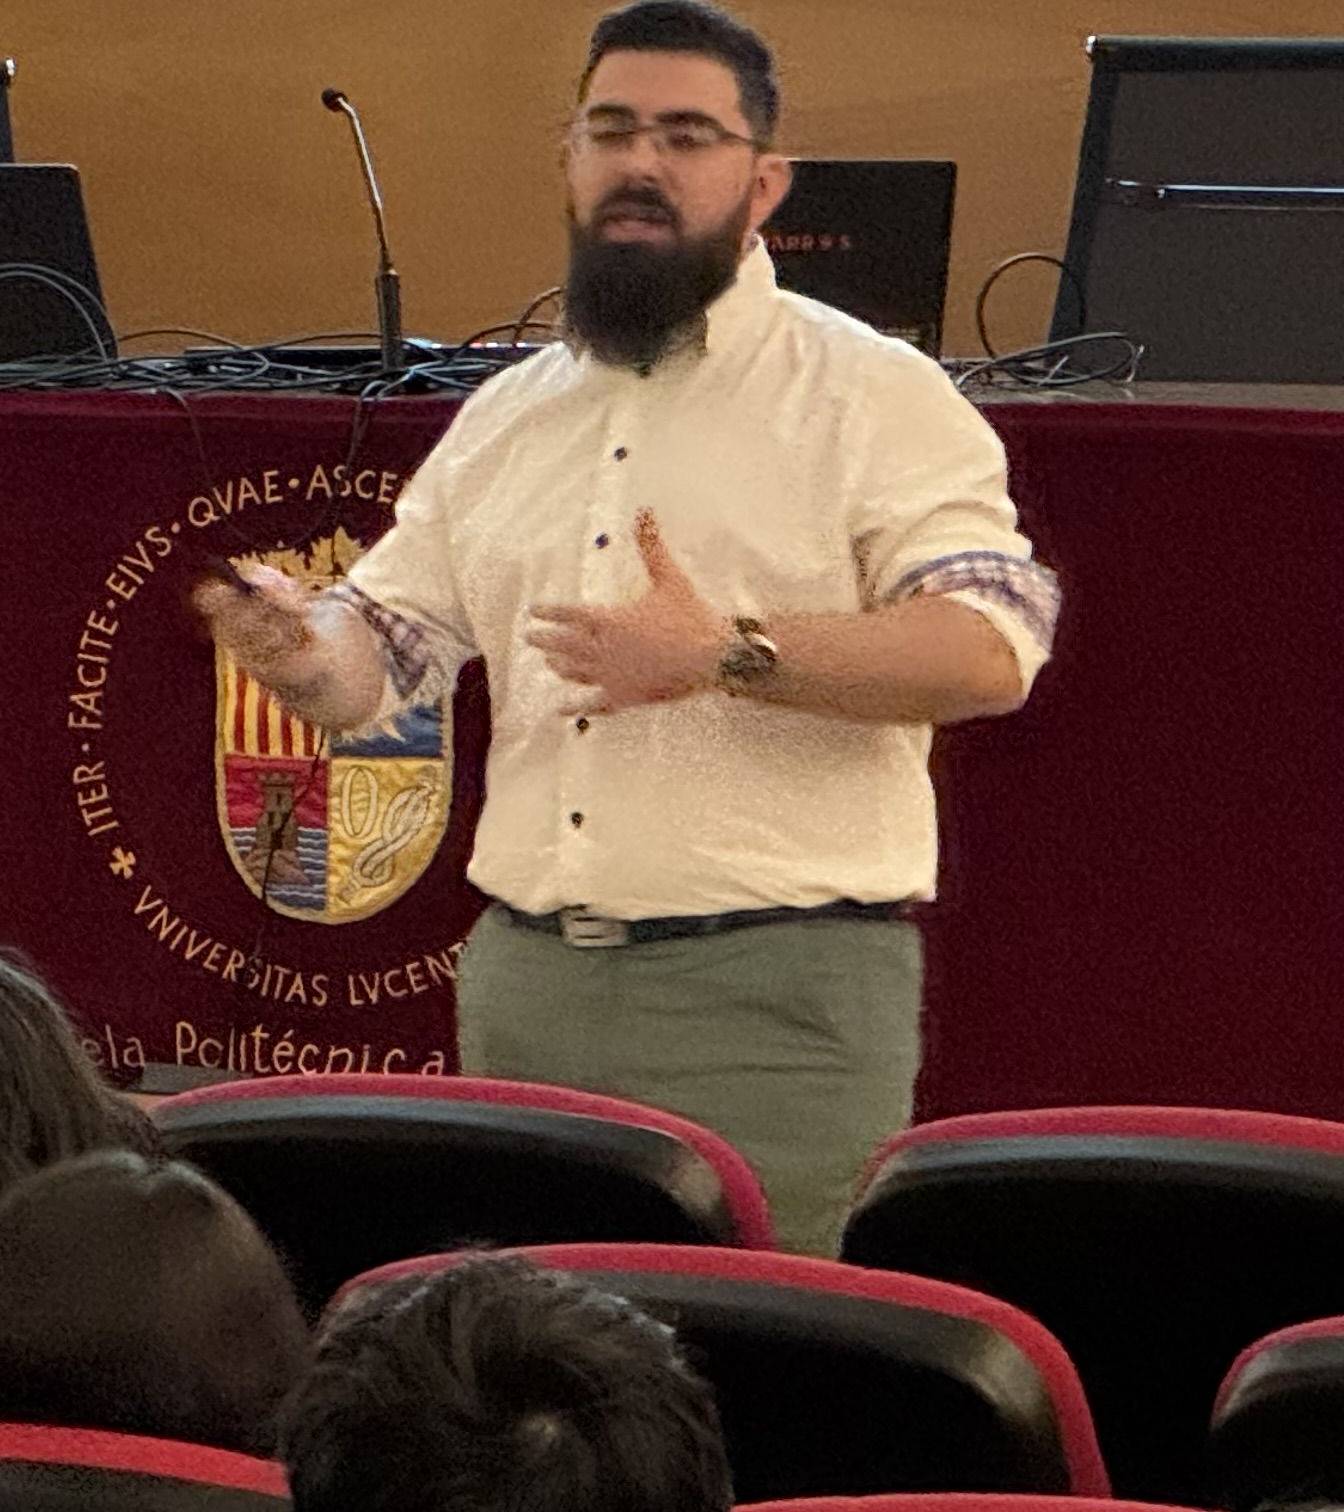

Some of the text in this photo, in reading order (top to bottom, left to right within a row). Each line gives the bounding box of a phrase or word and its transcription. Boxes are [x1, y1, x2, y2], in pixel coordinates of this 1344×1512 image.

[187, 469, 284, 527] QVAE
[104, 525, 173, 601] EIVS
[67, 609, 119, 730] FACITE
[72, 760, 119, 837] ITER
[133, 884, 330, 1008] VNIVERSITAS
